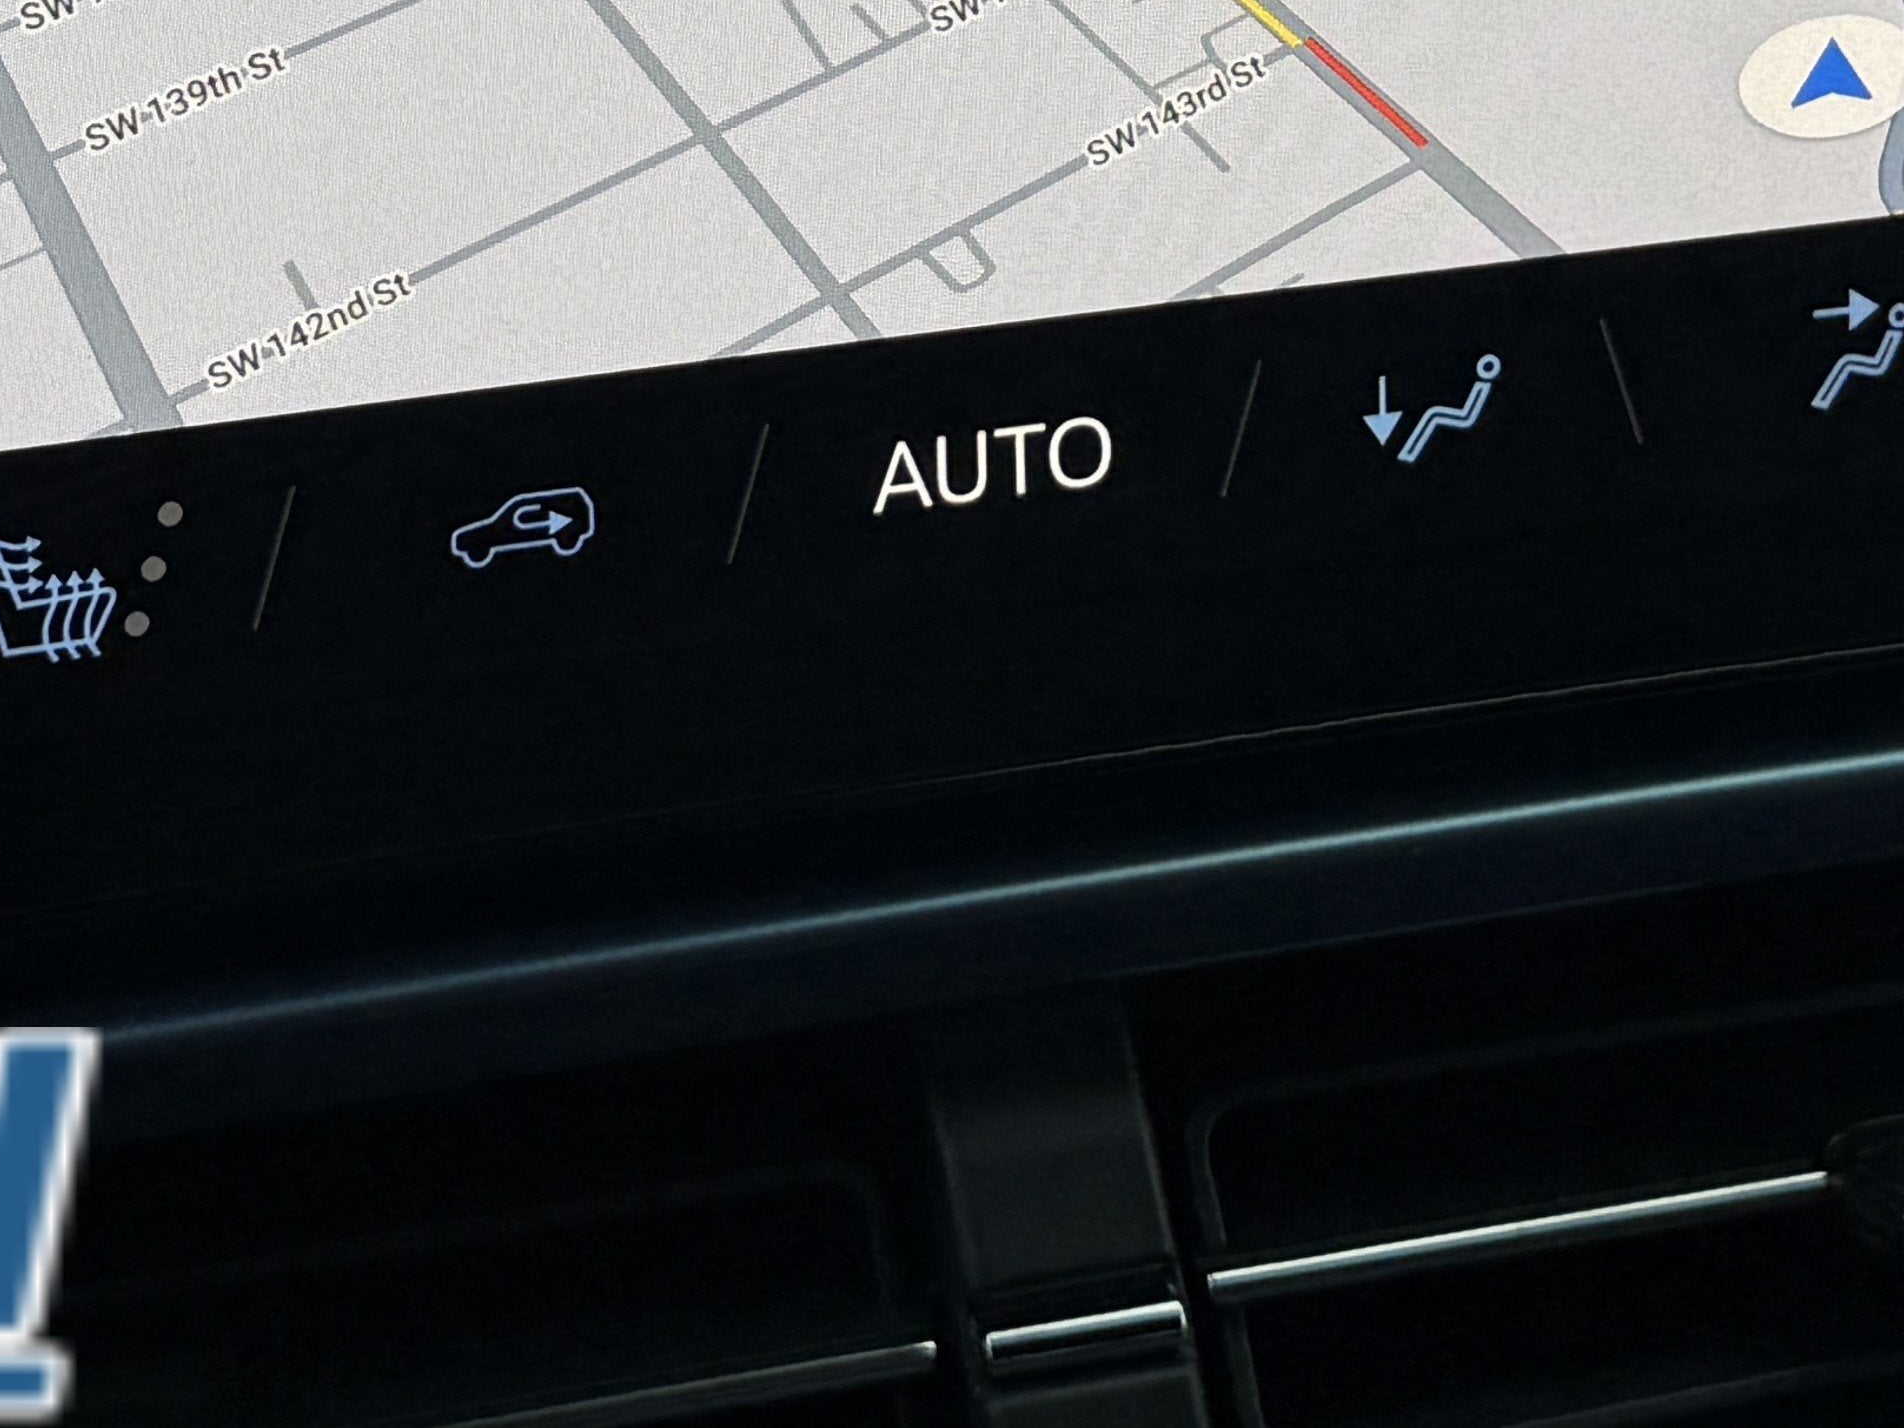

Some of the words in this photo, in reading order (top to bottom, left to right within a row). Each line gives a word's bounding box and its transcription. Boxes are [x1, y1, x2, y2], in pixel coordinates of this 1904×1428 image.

[85, 107, 138, 151] SW
[147, 67, 242, 123] 139th
[248, 48, 285, 80] St
[1087, 122, 1135, 166] SW
[1142, 73, 1227, 134] 143rd
[1226, 57, 1264, 88] St
[208, 343, 260, 388] SW
[264, 290, 368, 358] 142nd
[374, 270, 412, 309] St
[877, 418, 1113, 512] AUTO
